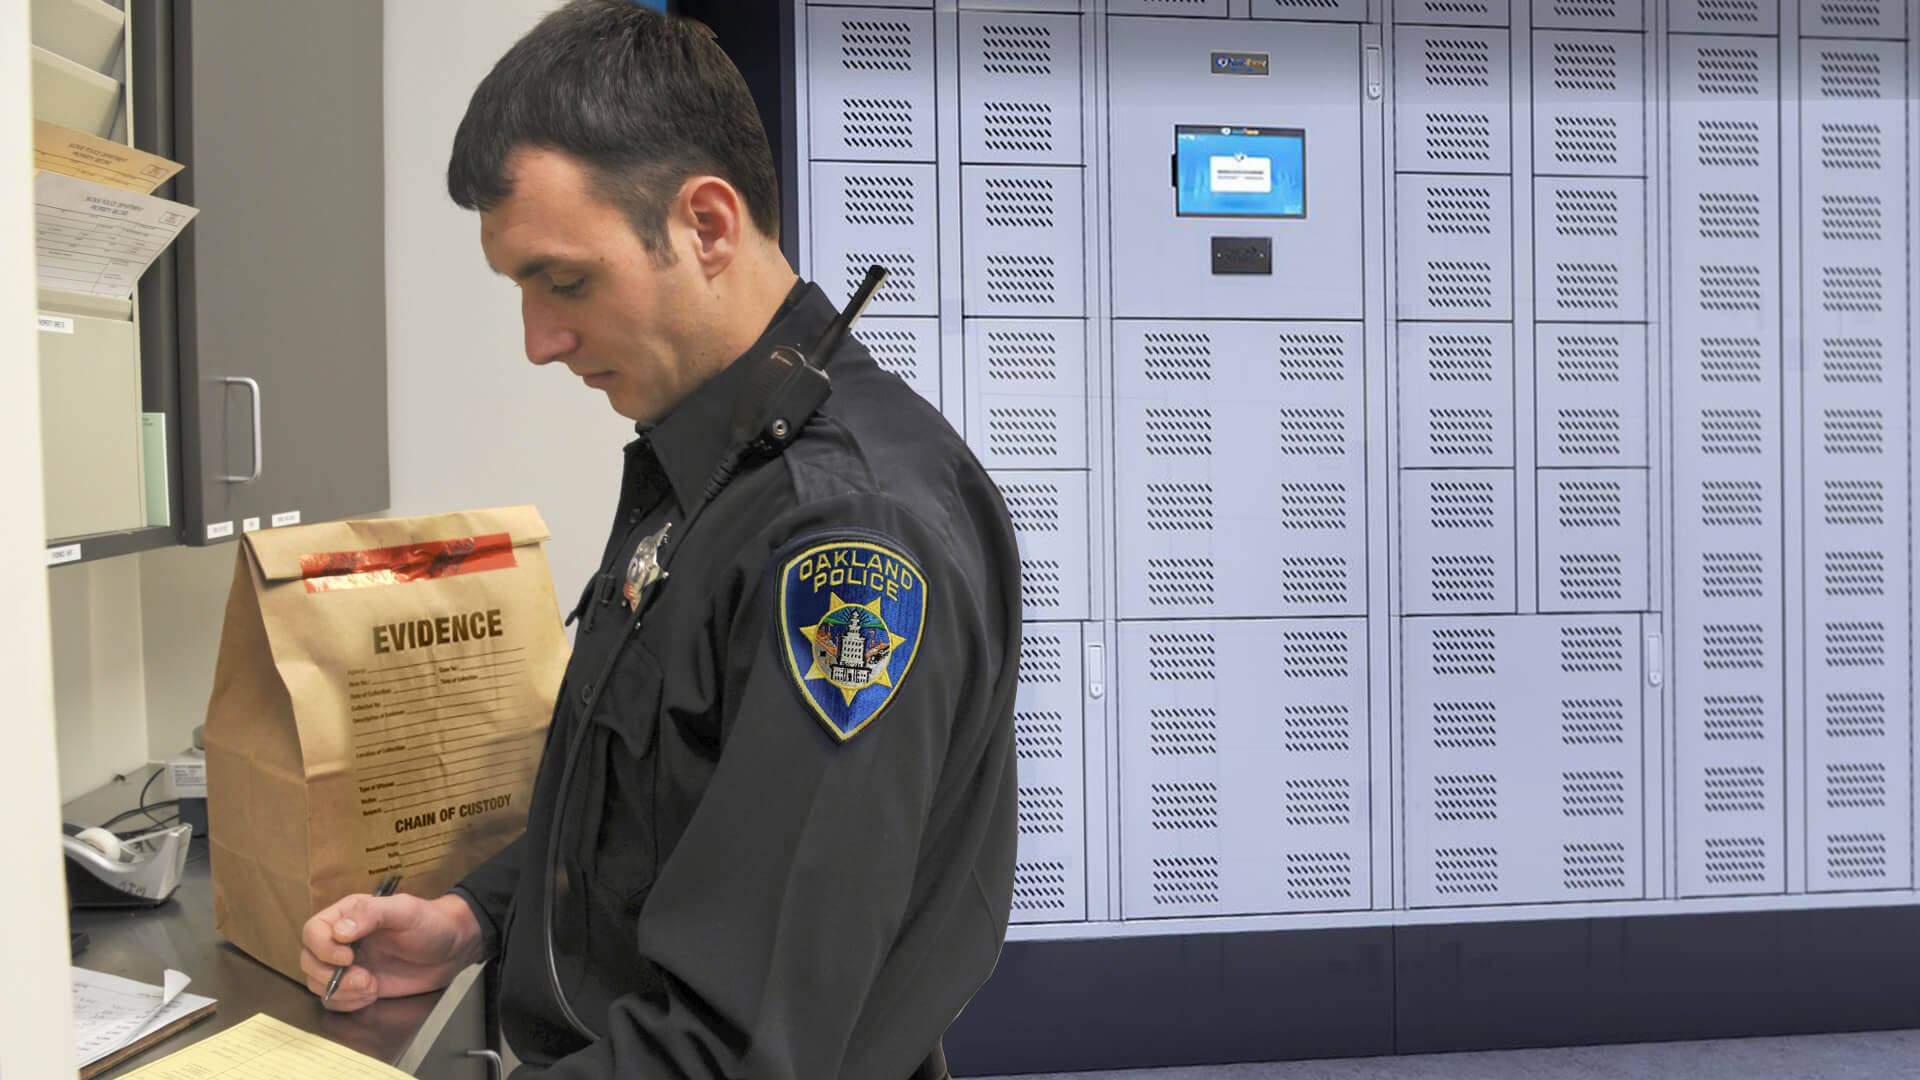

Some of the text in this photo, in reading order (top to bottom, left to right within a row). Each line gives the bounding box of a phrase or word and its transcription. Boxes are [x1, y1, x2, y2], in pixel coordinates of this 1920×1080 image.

[799, 550, 914, 591] OAKLAND
[813, 568, 900, 602] POLICE
[372, 609, 504, 655] EVIDENCE
[394, 793, 512, 834] CHAIN OF CUSTODY
